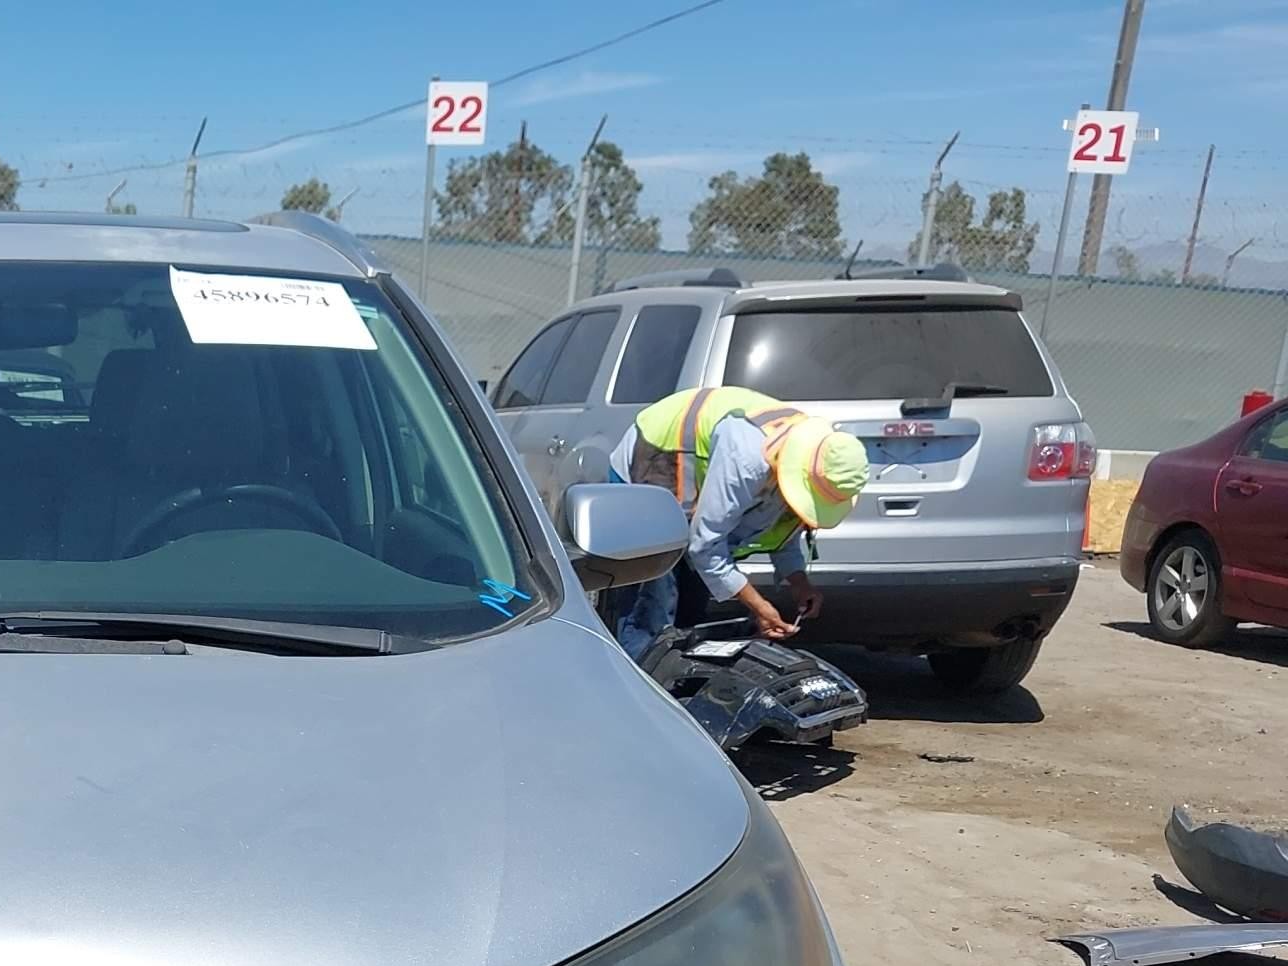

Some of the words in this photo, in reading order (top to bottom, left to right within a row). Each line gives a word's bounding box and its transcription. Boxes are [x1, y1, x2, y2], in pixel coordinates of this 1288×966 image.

[432, 95, 482, 132] 22
[1073, 122, 1127, 162] 21
[192, 288, 331, 308] 45896574
[883, 422, 935, 437] GMC
